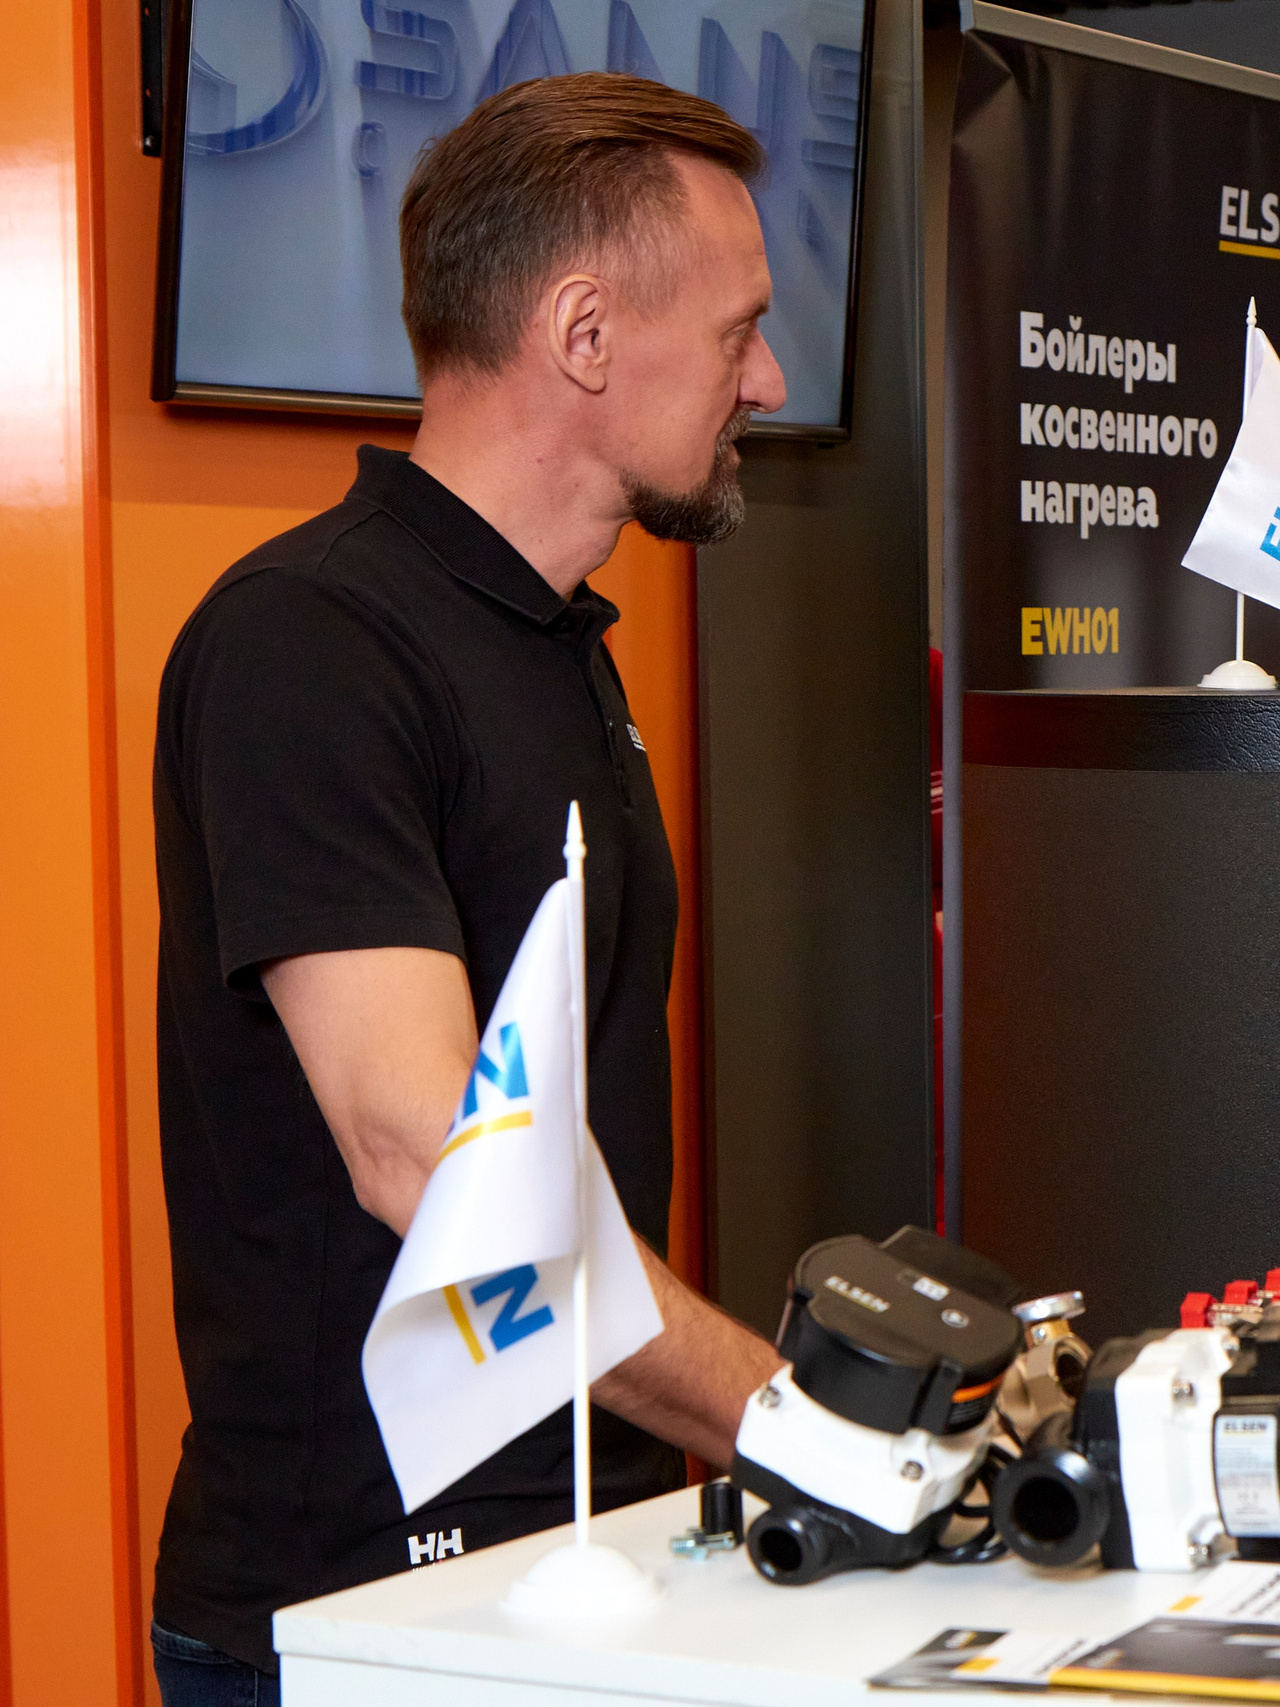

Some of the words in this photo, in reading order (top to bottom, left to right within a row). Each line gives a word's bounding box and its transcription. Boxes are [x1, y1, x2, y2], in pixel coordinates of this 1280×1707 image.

[1020, 311, 1177, 393] Бойлеры
[1020, 403, 1218, 459] косвенного
[1020, 480, 1160, 539] нагрева
[1021, 606, 1120, 655] EWH01
[407, 1527, 464, 1565] HH
